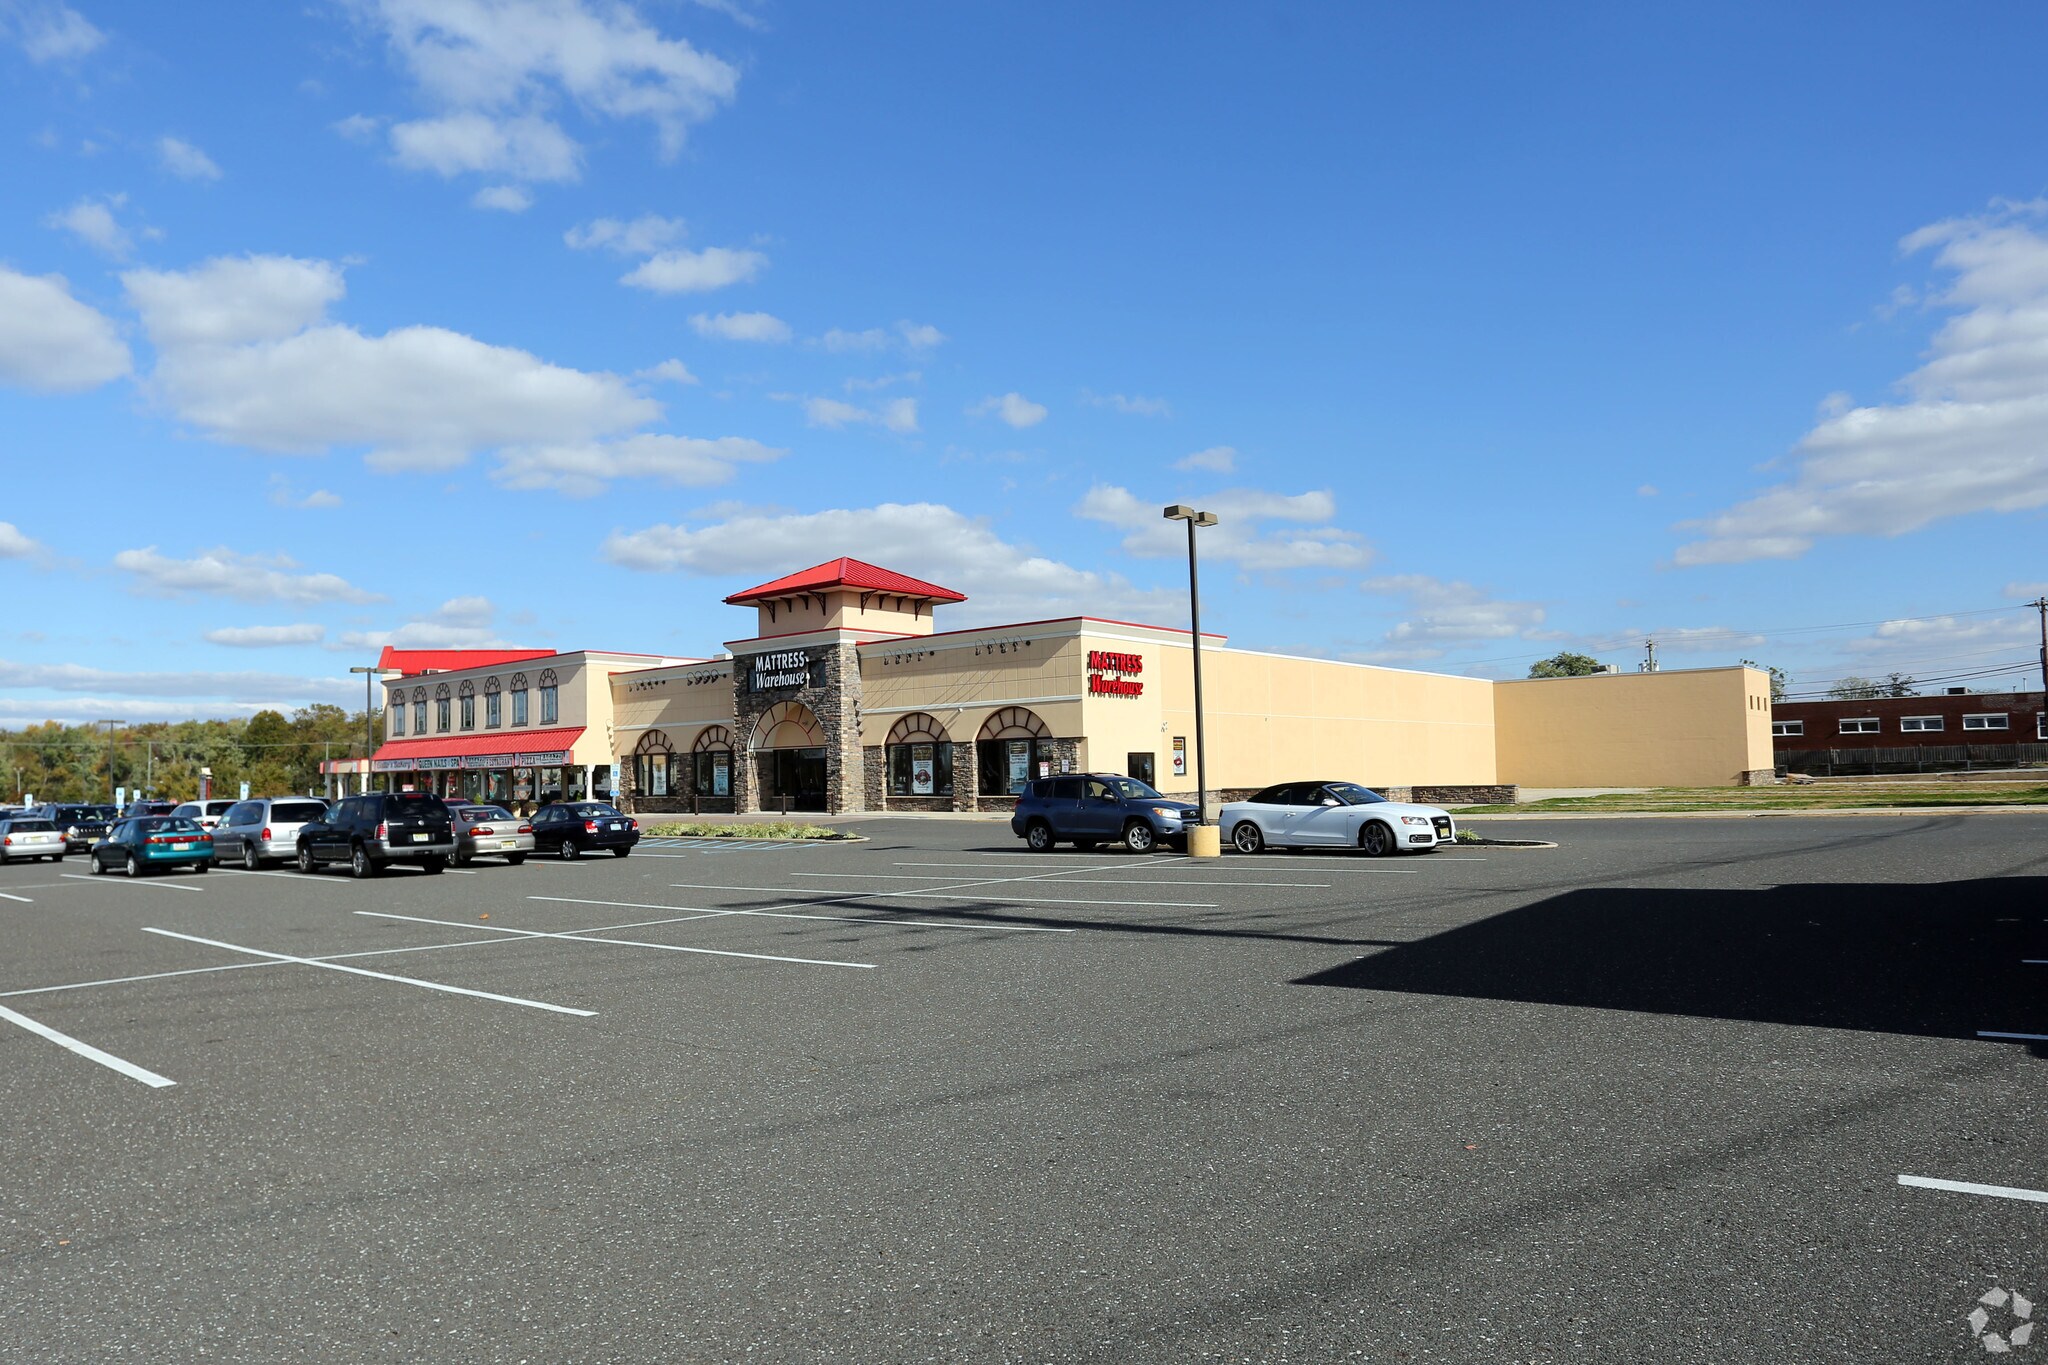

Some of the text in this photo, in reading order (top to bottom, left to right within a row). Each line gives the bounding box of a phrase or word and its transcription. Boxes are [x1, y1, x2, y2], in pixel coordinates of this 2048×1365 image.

[755, 650, 805, 672] MATTRESS
[1089, 650, 1143, 673] MATTRESS
[756, 671, 805, 689] Warehouse
[1089, 674, 1144, 695] Warehouse
[419, 759, 433, 769] QUEEN
[433, 758, 447, 768] NAILS
[450, 757, 460, 768] SPA
[521, 756, 536, 765] PIZZA
